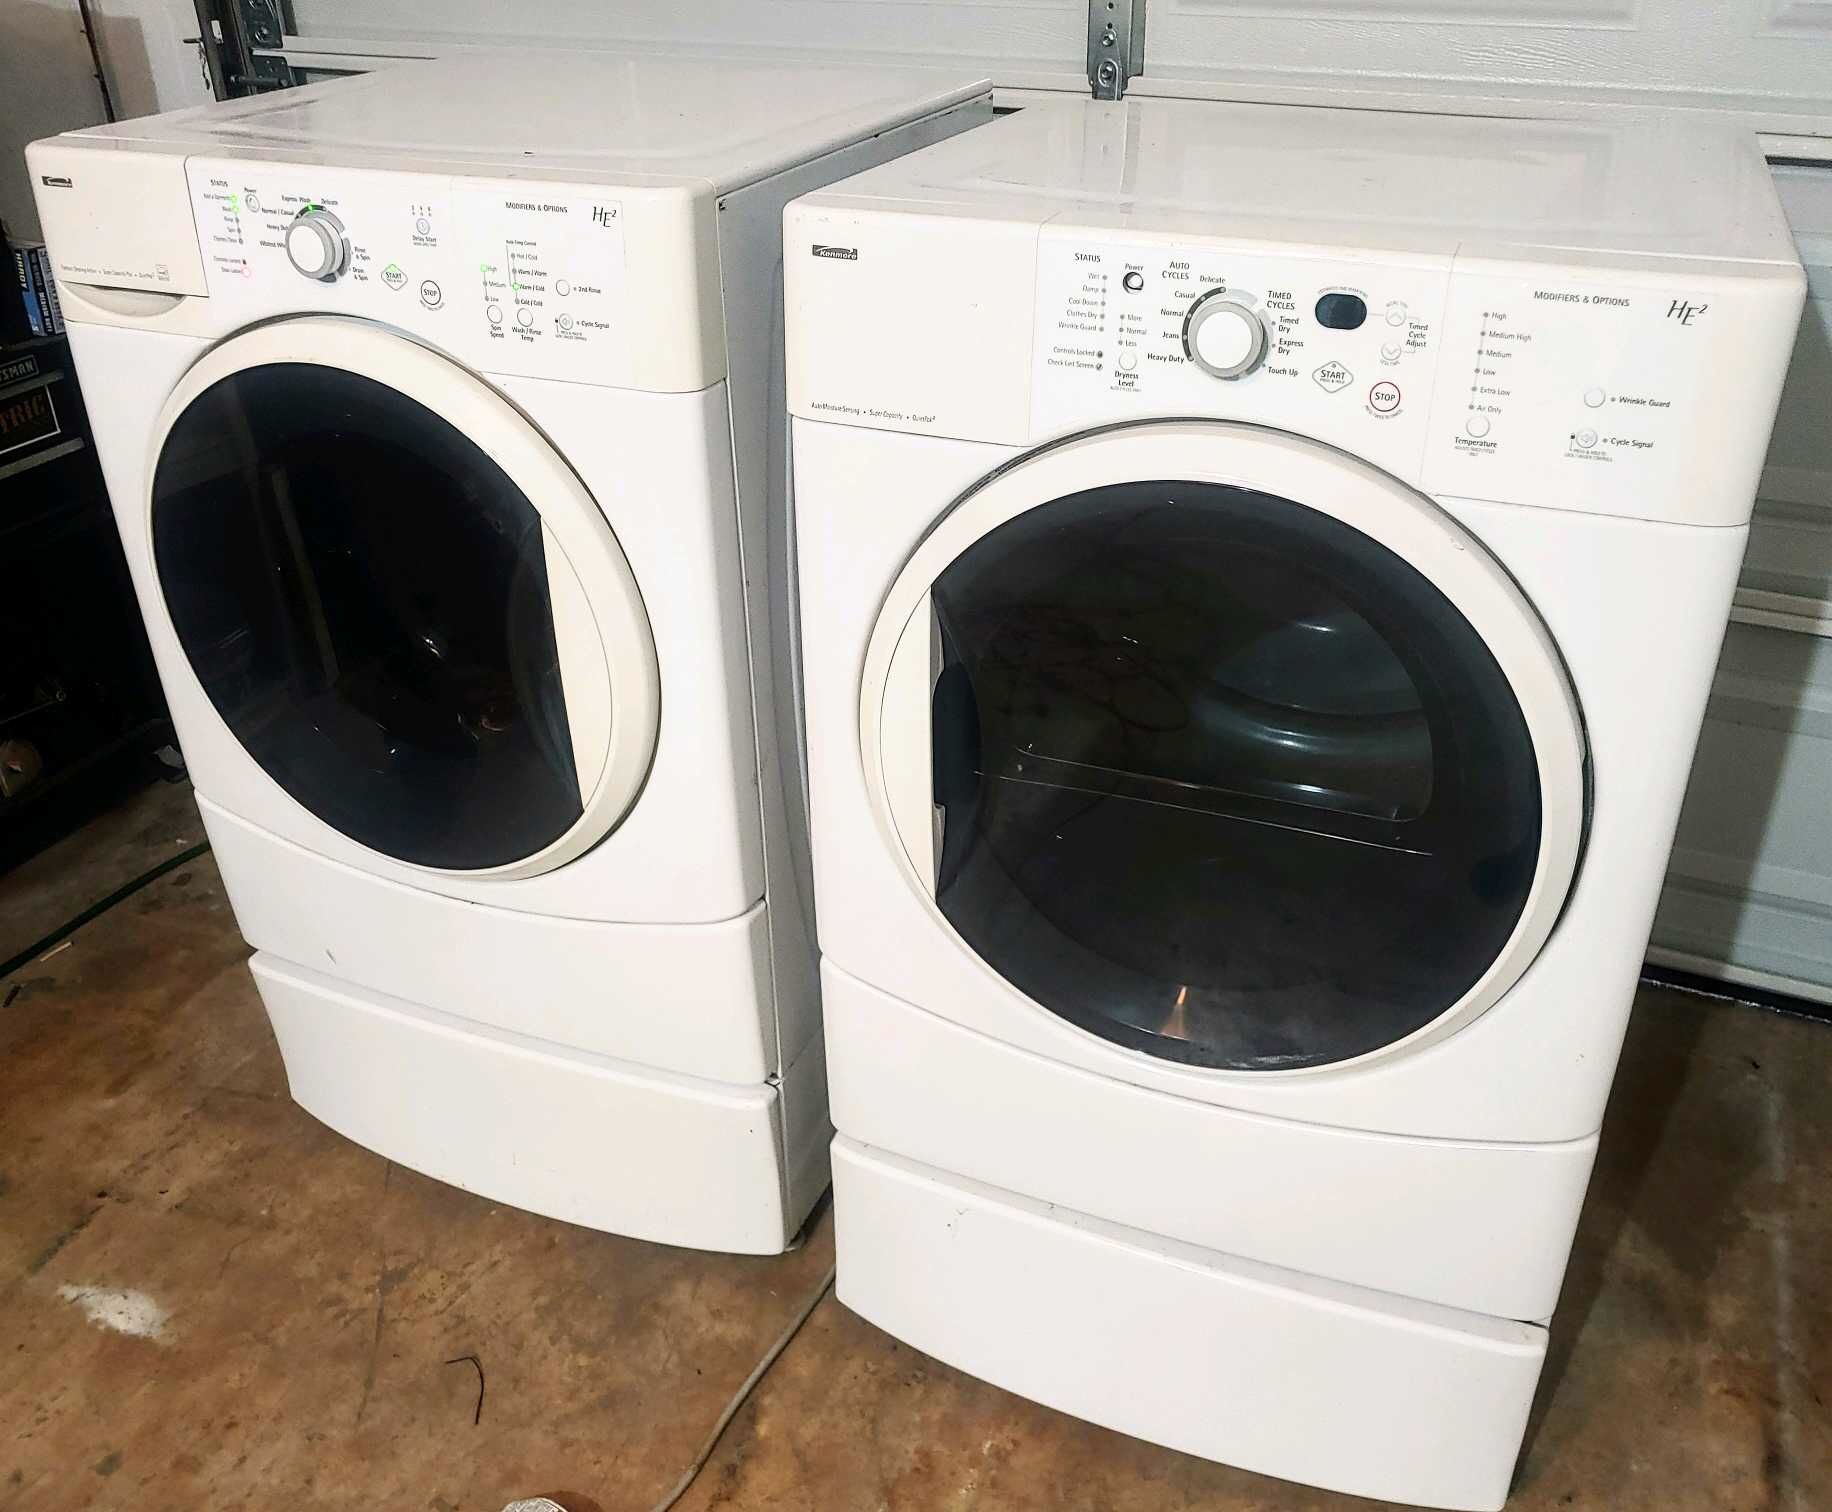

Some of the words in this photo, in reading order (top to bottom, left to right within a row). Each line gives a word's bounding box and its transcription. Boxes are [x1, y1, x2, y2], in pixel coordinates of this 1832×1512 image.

[505, 201, 536, 212] MODIFIERS
[543, 204, 568, 214] OPTIONS
[1074, 252, 1101, 263] STATUS
[1124, 263, 1144, 271] Power
[1169, 261, 1190, 270] AUTO
[1161, 270, 1190, 280] CYCLES
[1199, 275, 1226, 284] Delicate
[423, 288, 438, 297] STOP
[1174, 291, 1196, 299] Casual
[1268, 290, 1292, 300] TIMED
[1533, 290, 1580, 303] MODIFIERS
[1582, 295, 1590, 304] &
[1592, 295, 1630, 307] OPTIONS
[1266, 300, 1295, 311] CYCLES
[1160, 308, 1184, 317] Normal
[1491, 311, 1507, 321] High
[1279, 316, 1300, 325] Timed
[1278, 325, 1291, 334] Dry
[1162, 331, 1180, 340] Jeans
[1279, 337, 1305, 348] Express
[1278, 347, 1291, 356] Dry
[1147, 353, 1167, 363] Heavy
[1168, 354, 1185, 365] Duty
[1114, 370, 1139, 380] Dryness
[1268, 366, 1287, 375] Touch
[1288, 368, 1299, 377] Up
[1320, 369, 1346, 380] START
[1118, 379, 1135, 388] Level
[1375, 391, 1396, 402] STOP
[1454, 436, 1498, 448] Temperature
[1610, 437, 1630, 447] Cycle
[1631, 439, 1654, 449] Signal
